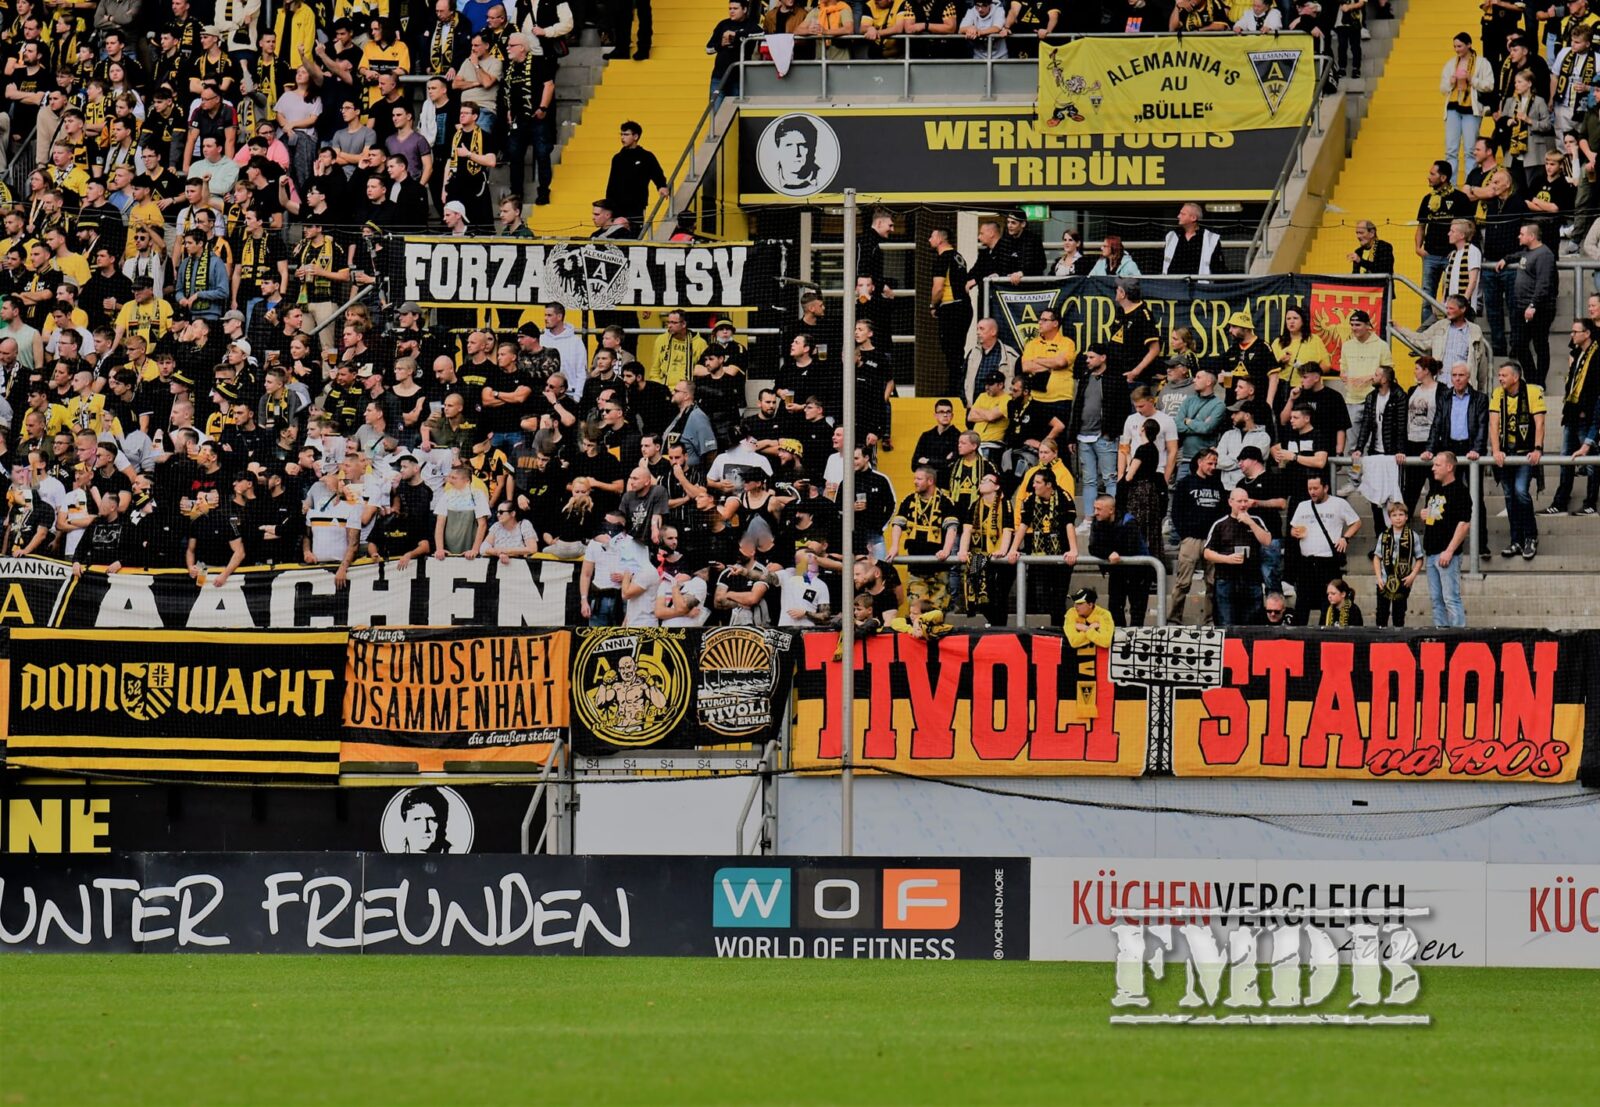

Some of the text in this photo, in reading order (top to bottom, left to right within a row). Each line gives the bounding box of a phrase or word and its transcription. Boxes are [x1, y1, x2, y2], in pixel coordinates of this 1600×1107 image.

[1106, 50, 1240, 86] ALEMANNIA'S
[1252, 51, 1297, 61] ALEMANNIA
[1161, 76, 1188, 92] AU
[993, 150, 1166, 186] TRIBÜNE
[404, 243, 747, 307] FORZA ATSV
[583, 249, 624, 264] ALEMANNIA
[95, 557, 574, 628] AACHEN
[352, 635, 553, 685] REUNDSCHAFT
[20, 662, 335, 718] DOM WACHT
[350, 680, 555, 731] USAMMENHALT
[804, 631, 1559, 768] TIVOLI STADION
[704, 701, 767, 723] TIVOLI
[468, 732, 484, 745] die
[485, 730, 527, 746] draußen
[586, 758, 748, 769] S4 S4 S4 S4 S4
[1449, 739, 1571, 778] 1908
[0, 871, 631, 948] UNTER FREUNDEN
[994, 868, 1004, 949] MOHR UND MORE
[1072, 869, 1406, 927] KÜCHENVERGLEICH
[714, 936, 956, 961] WORLD OF FITNESS
